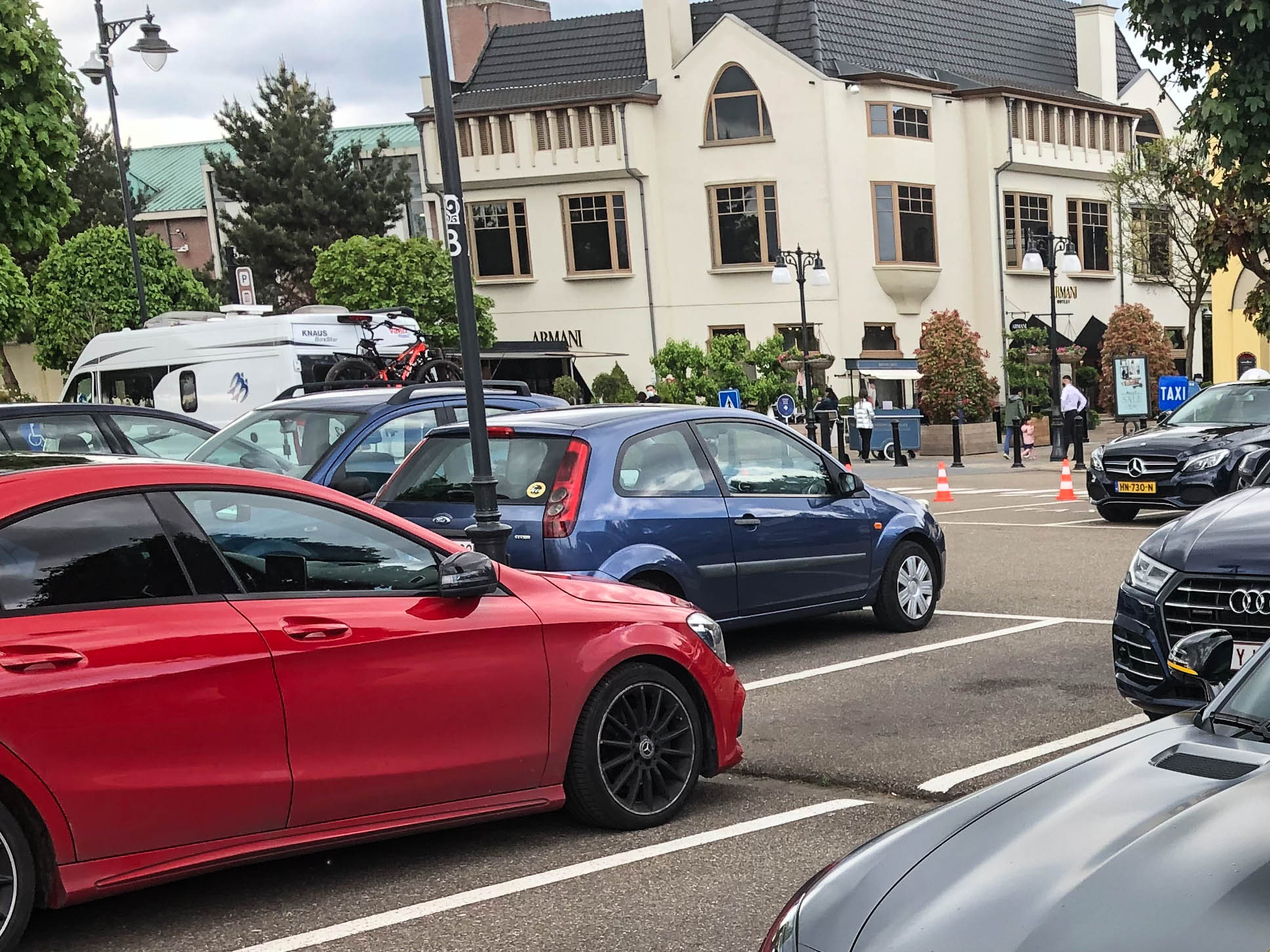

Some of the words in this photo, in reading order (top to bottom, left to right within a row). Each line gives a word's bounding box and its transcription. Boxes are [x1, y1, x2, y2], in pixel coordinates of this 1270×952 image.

[301, 329, 328, 337] KNAUS
[1160, 386, 1187, 401] TAXI
[1119, 483, 1154, 492] HN-730-N
